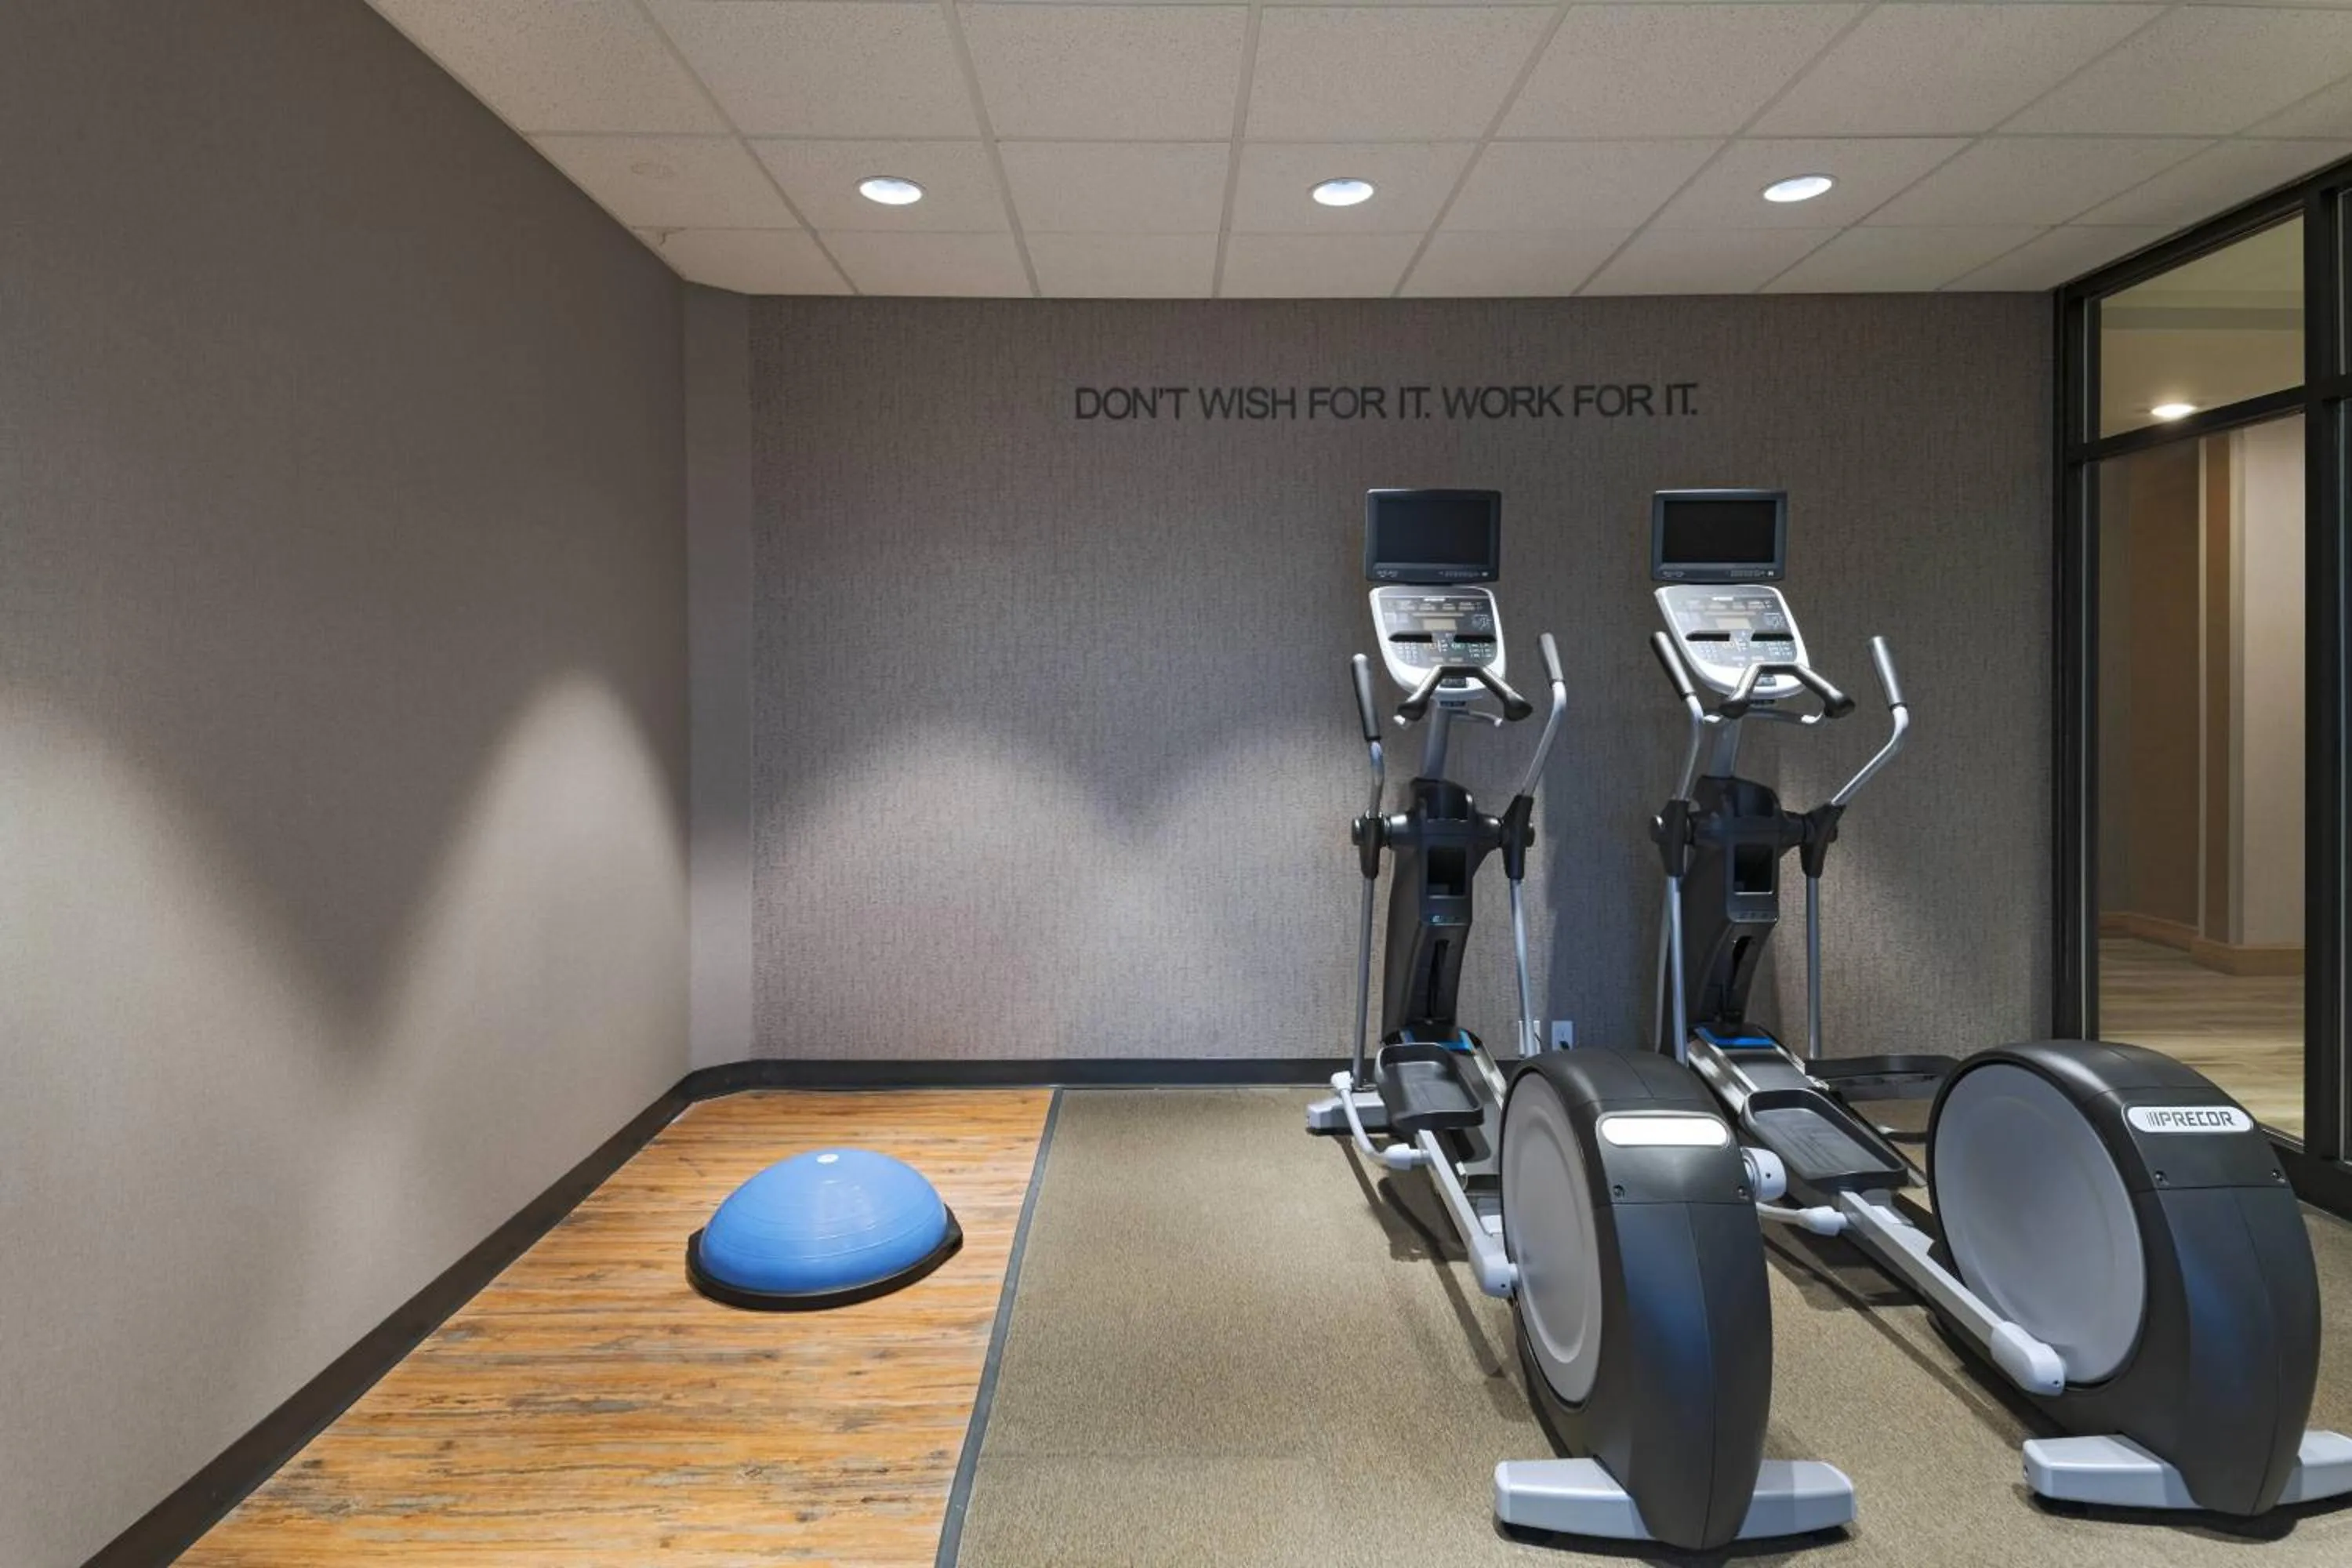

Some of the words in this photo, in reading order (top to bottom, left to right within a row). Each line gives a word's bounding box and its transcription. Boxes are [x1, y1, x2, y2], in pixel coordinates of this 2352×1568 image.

[1075, 387, 1189, 419] DON'T
[1198, 387, 1296, 420] WISH
[1308, 387, 1387, 419] FOR
[1399, 387, 1431, 419] IT.
[1441, 385, 1564, 419] WORK
[1573, 384, 1654, 418] FOR
[1665, 383, 1699, 416] IT.
[2159, 1111, 2233, 1126] PRECOR
